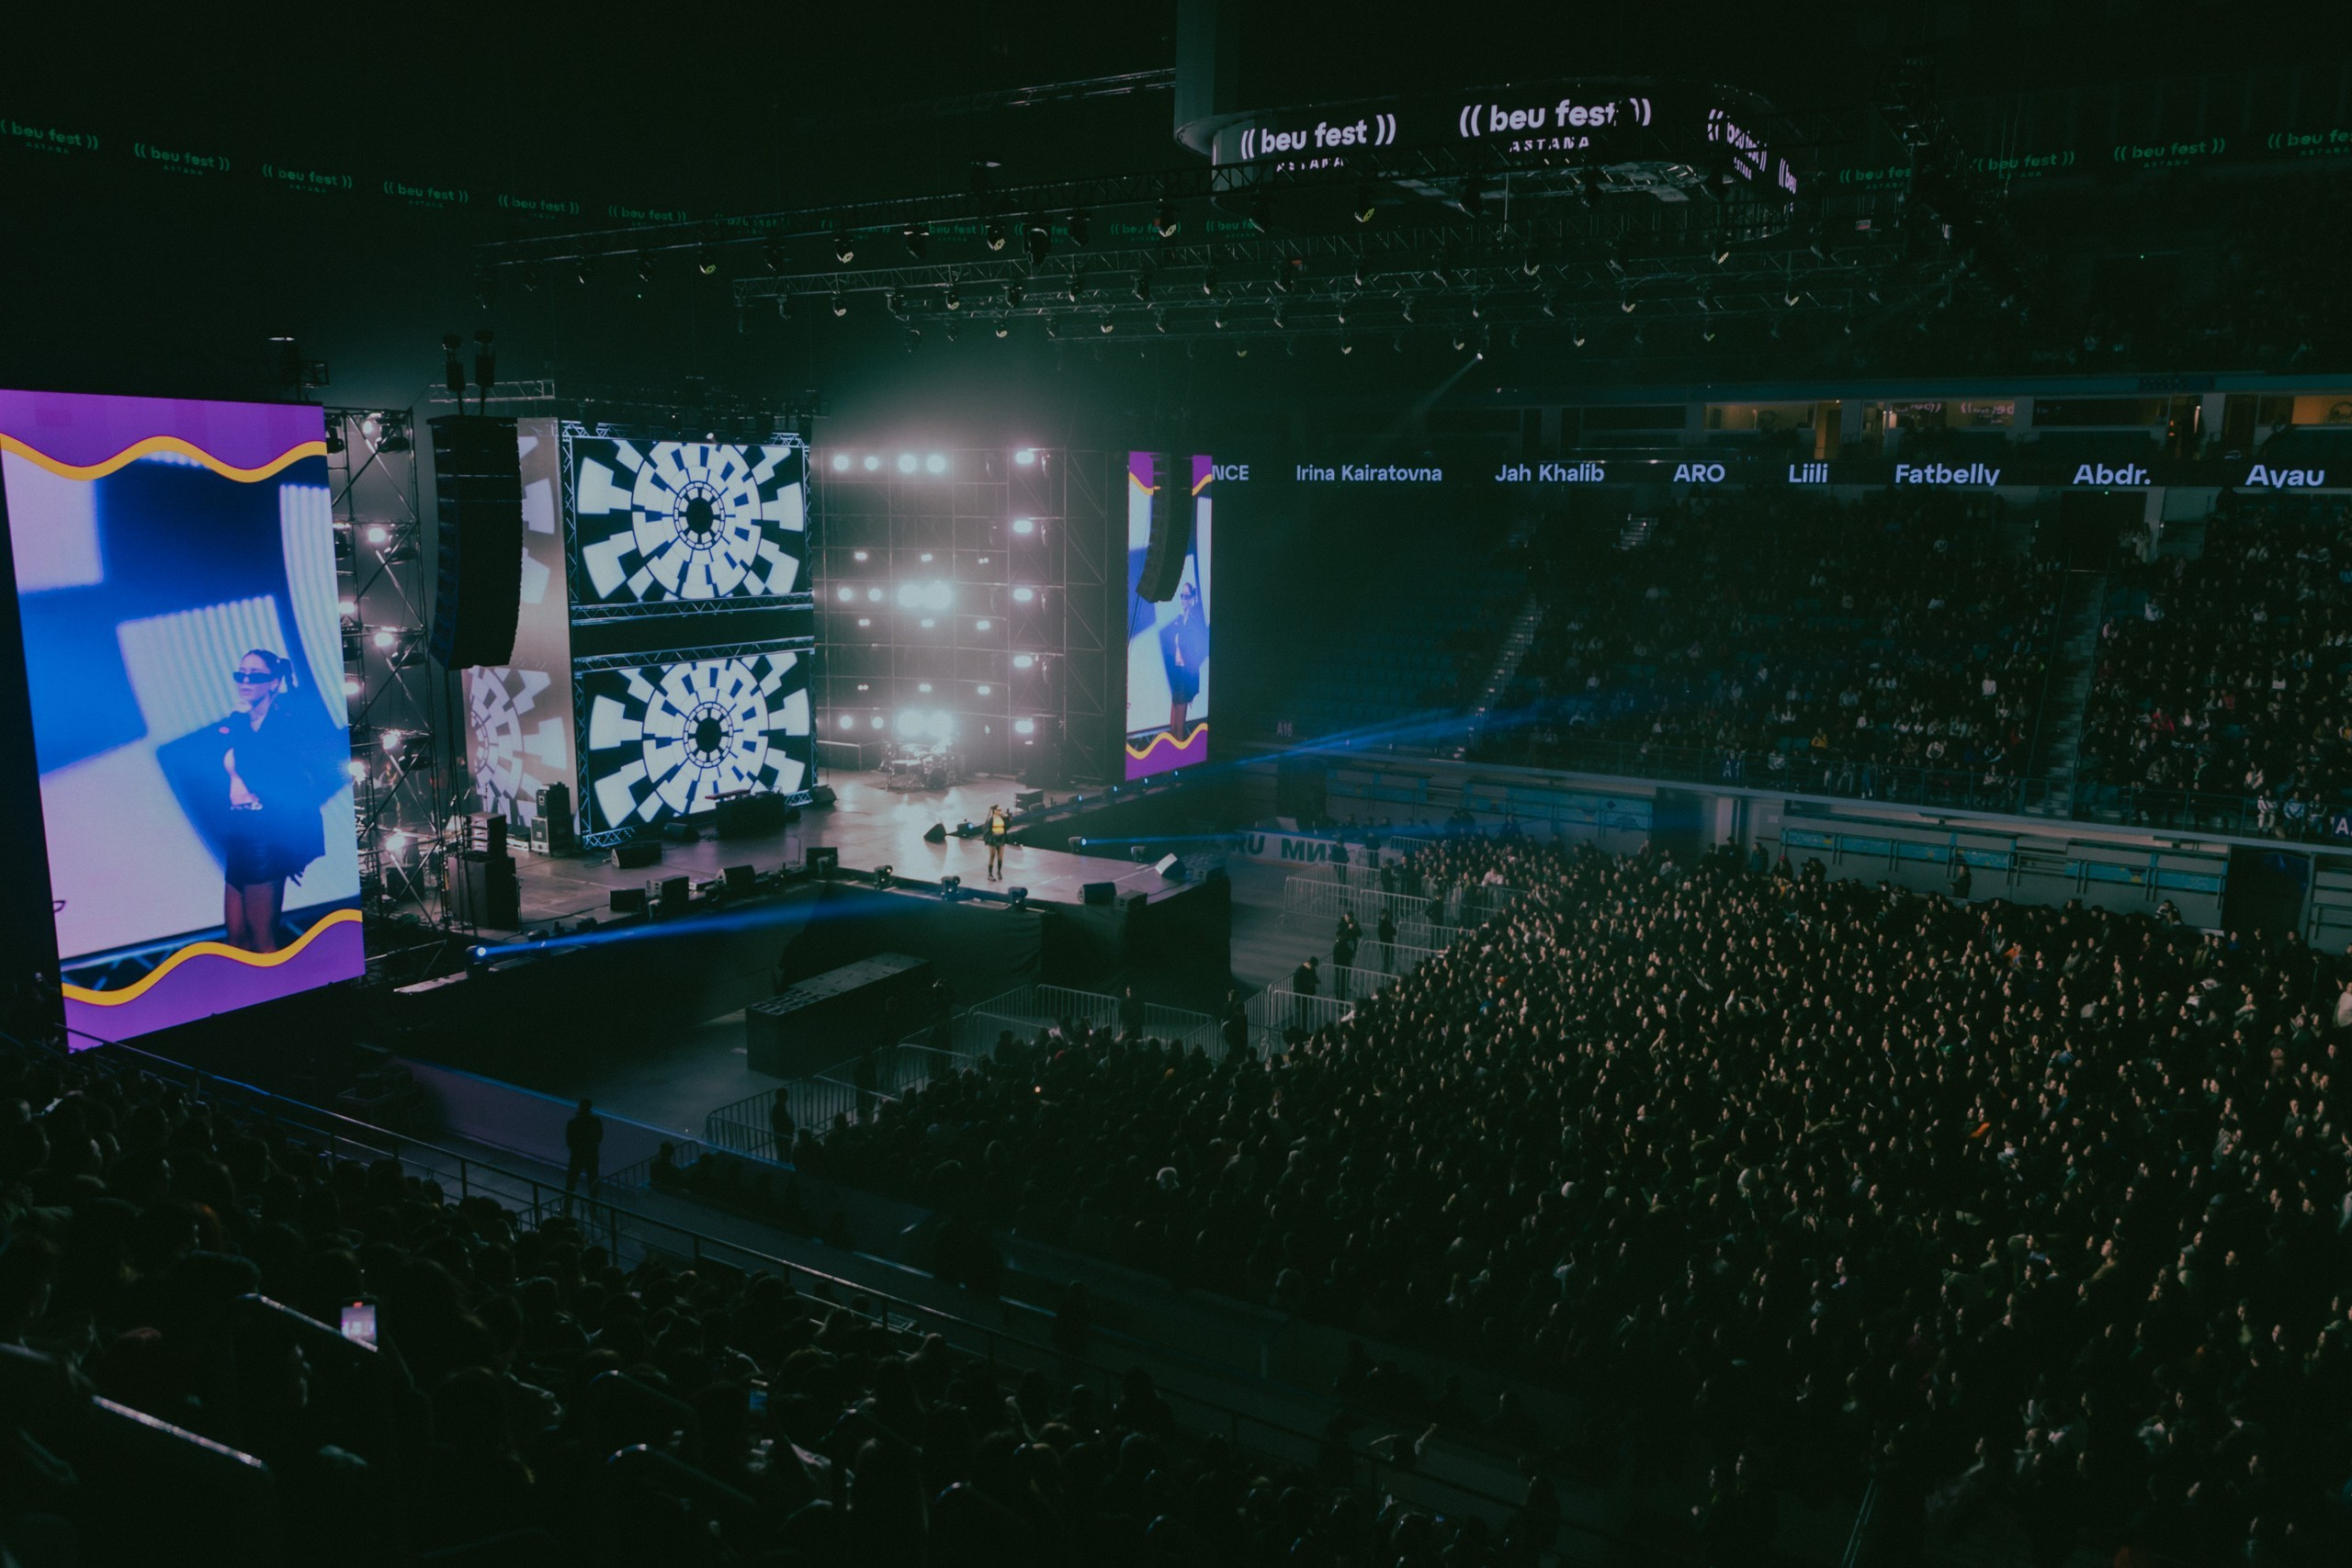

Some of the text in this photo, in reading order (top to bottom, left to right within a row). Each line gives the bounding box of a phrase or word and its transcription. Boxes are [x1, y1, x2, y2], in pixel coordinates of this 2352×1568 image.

[1489, 105, 1545, 131] beu
[12, 121, 82, 146] beu fest
[1261, 119, 1367, 153] beu fest
[1888, 166, 1911, 179] fes
[1296, 464, 1442, 481] Irina Kairatovna
[1495, 463, 1605, 482] Jah Khalib
[1673, 464, 1725, 482] ARO
[1789, 463, 1828, 483] Liili
[1895, 463, 2000, 486] Fatbelly
[2073, 463, 2151, 485] Abdr.
